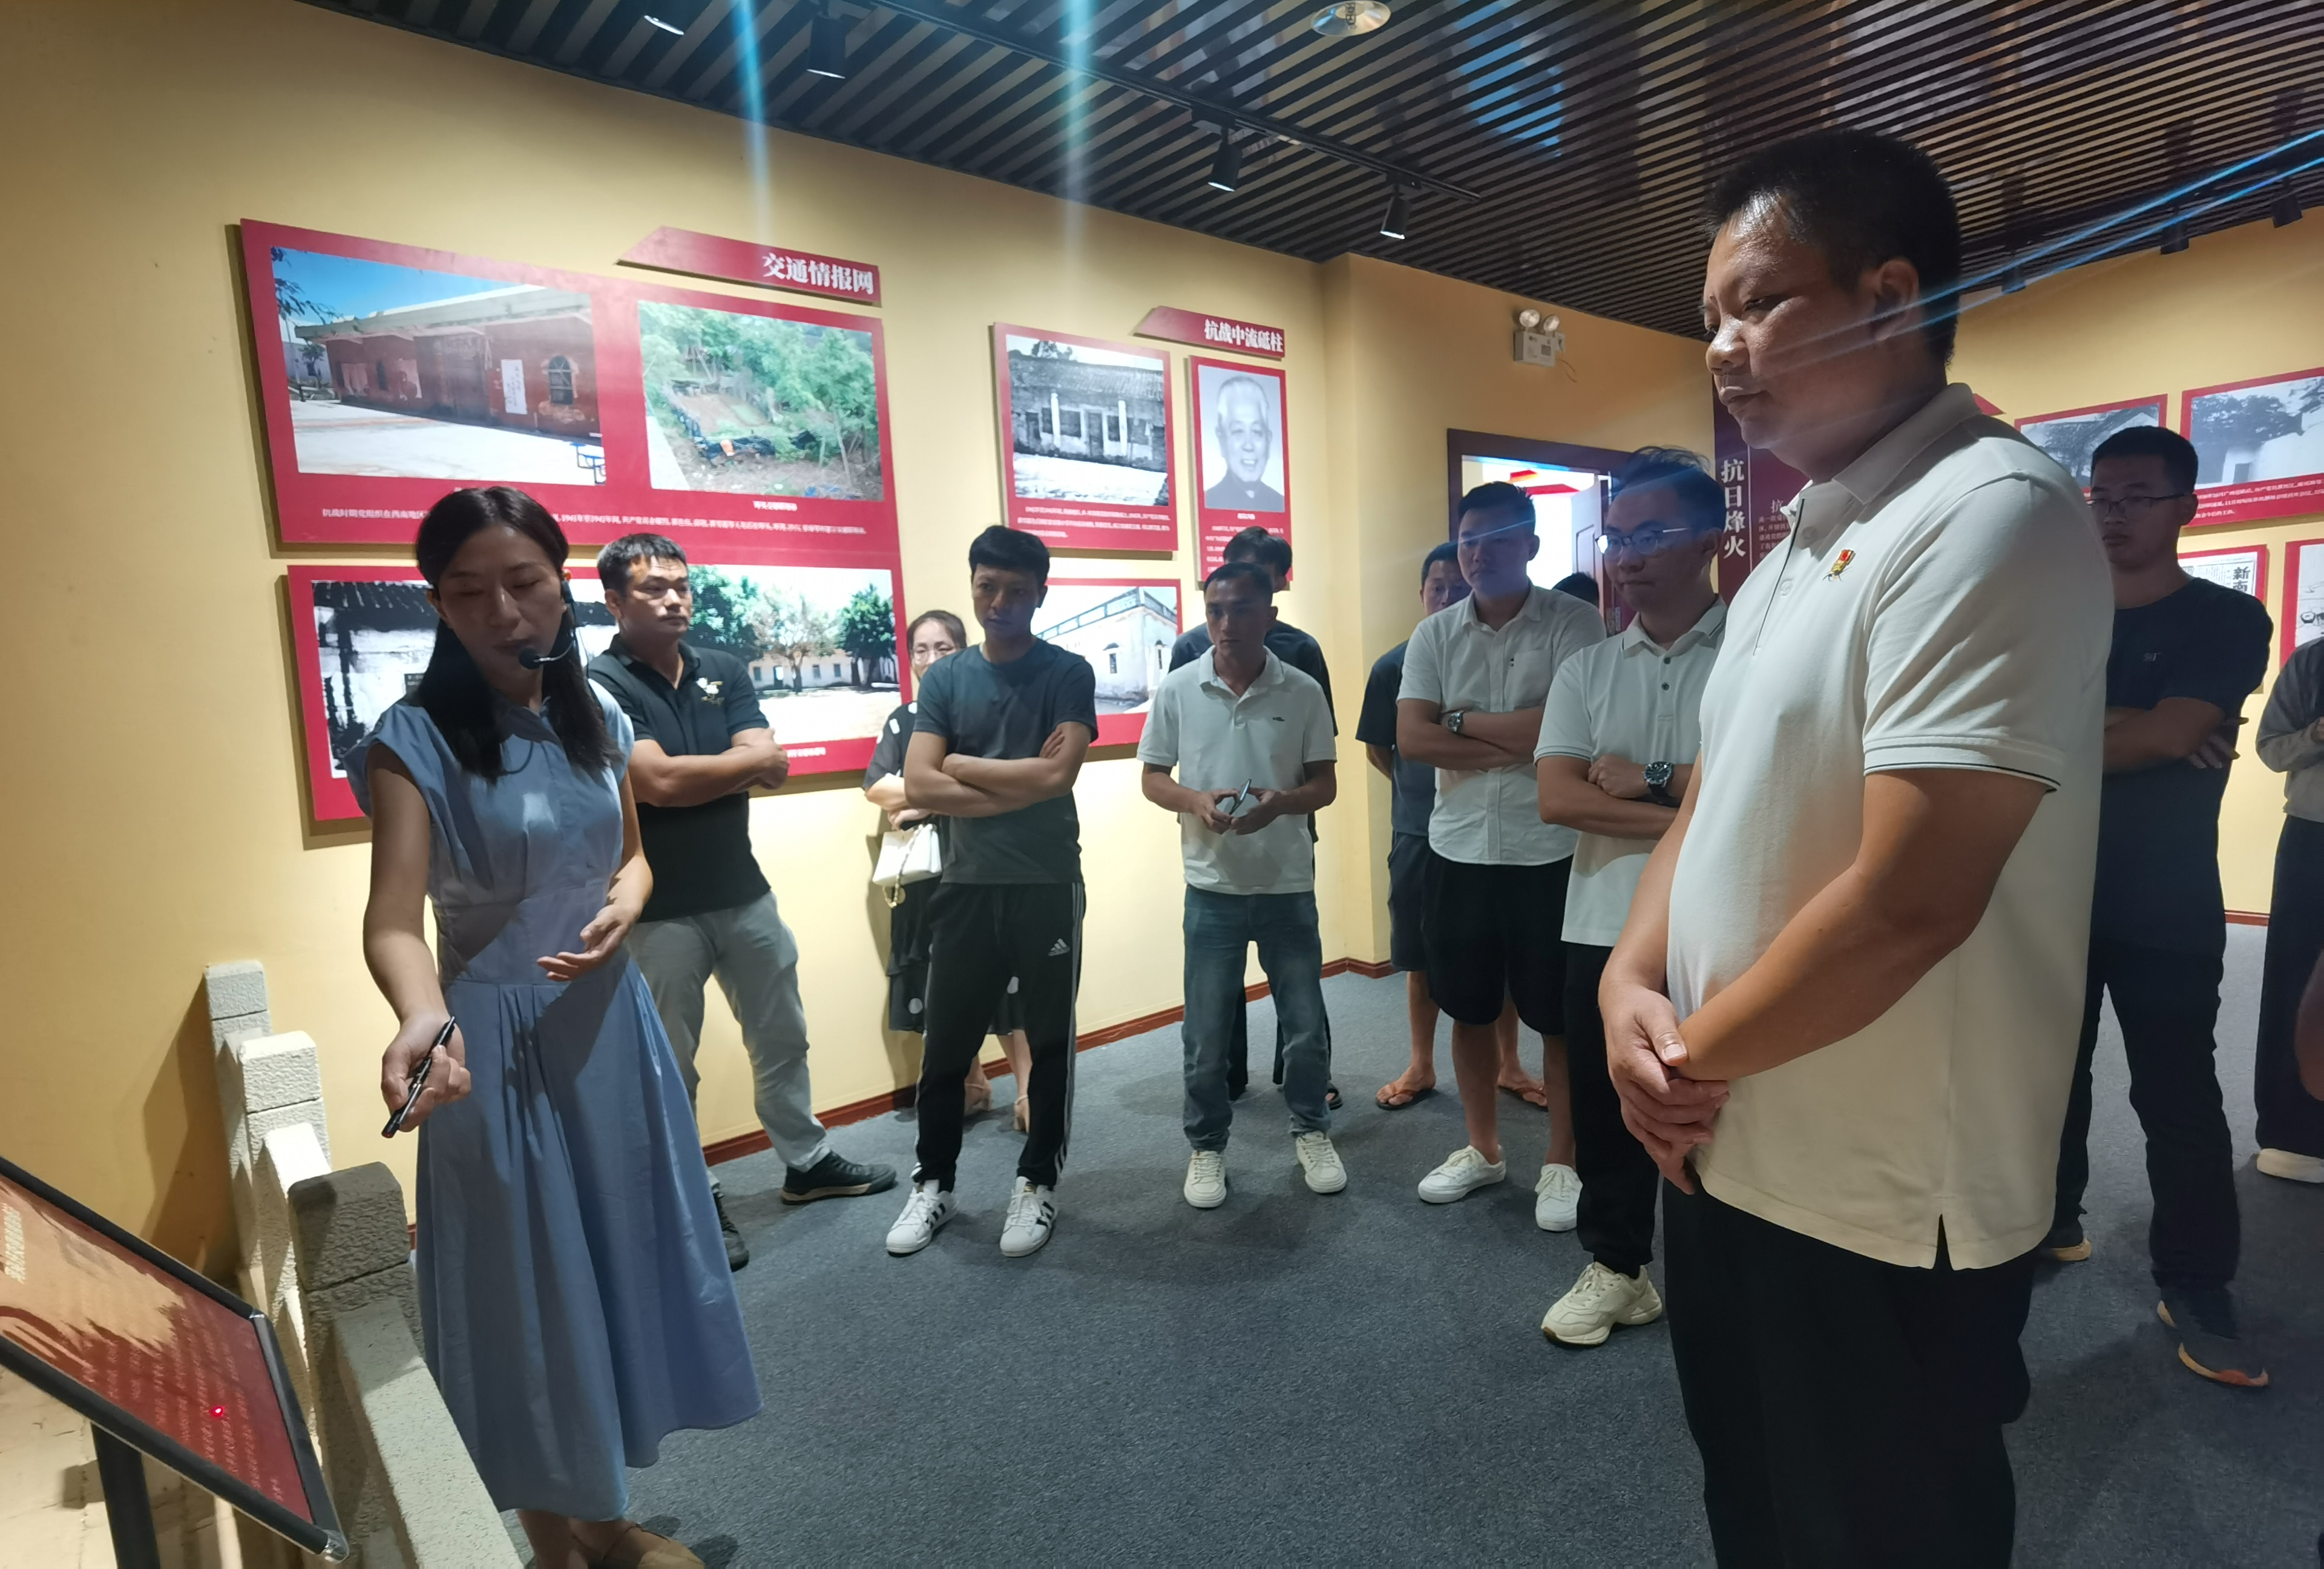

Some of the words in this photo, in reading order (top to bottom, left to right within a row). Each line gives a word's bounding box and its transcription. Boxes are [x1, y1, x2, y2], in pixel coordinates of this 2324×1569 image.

[762, 252, 874, 295] 交通情报网
[1204, 318, 1284, 352] 抗战中流砥柱
[1721, 458, 1747, 559] 抗日烽火
